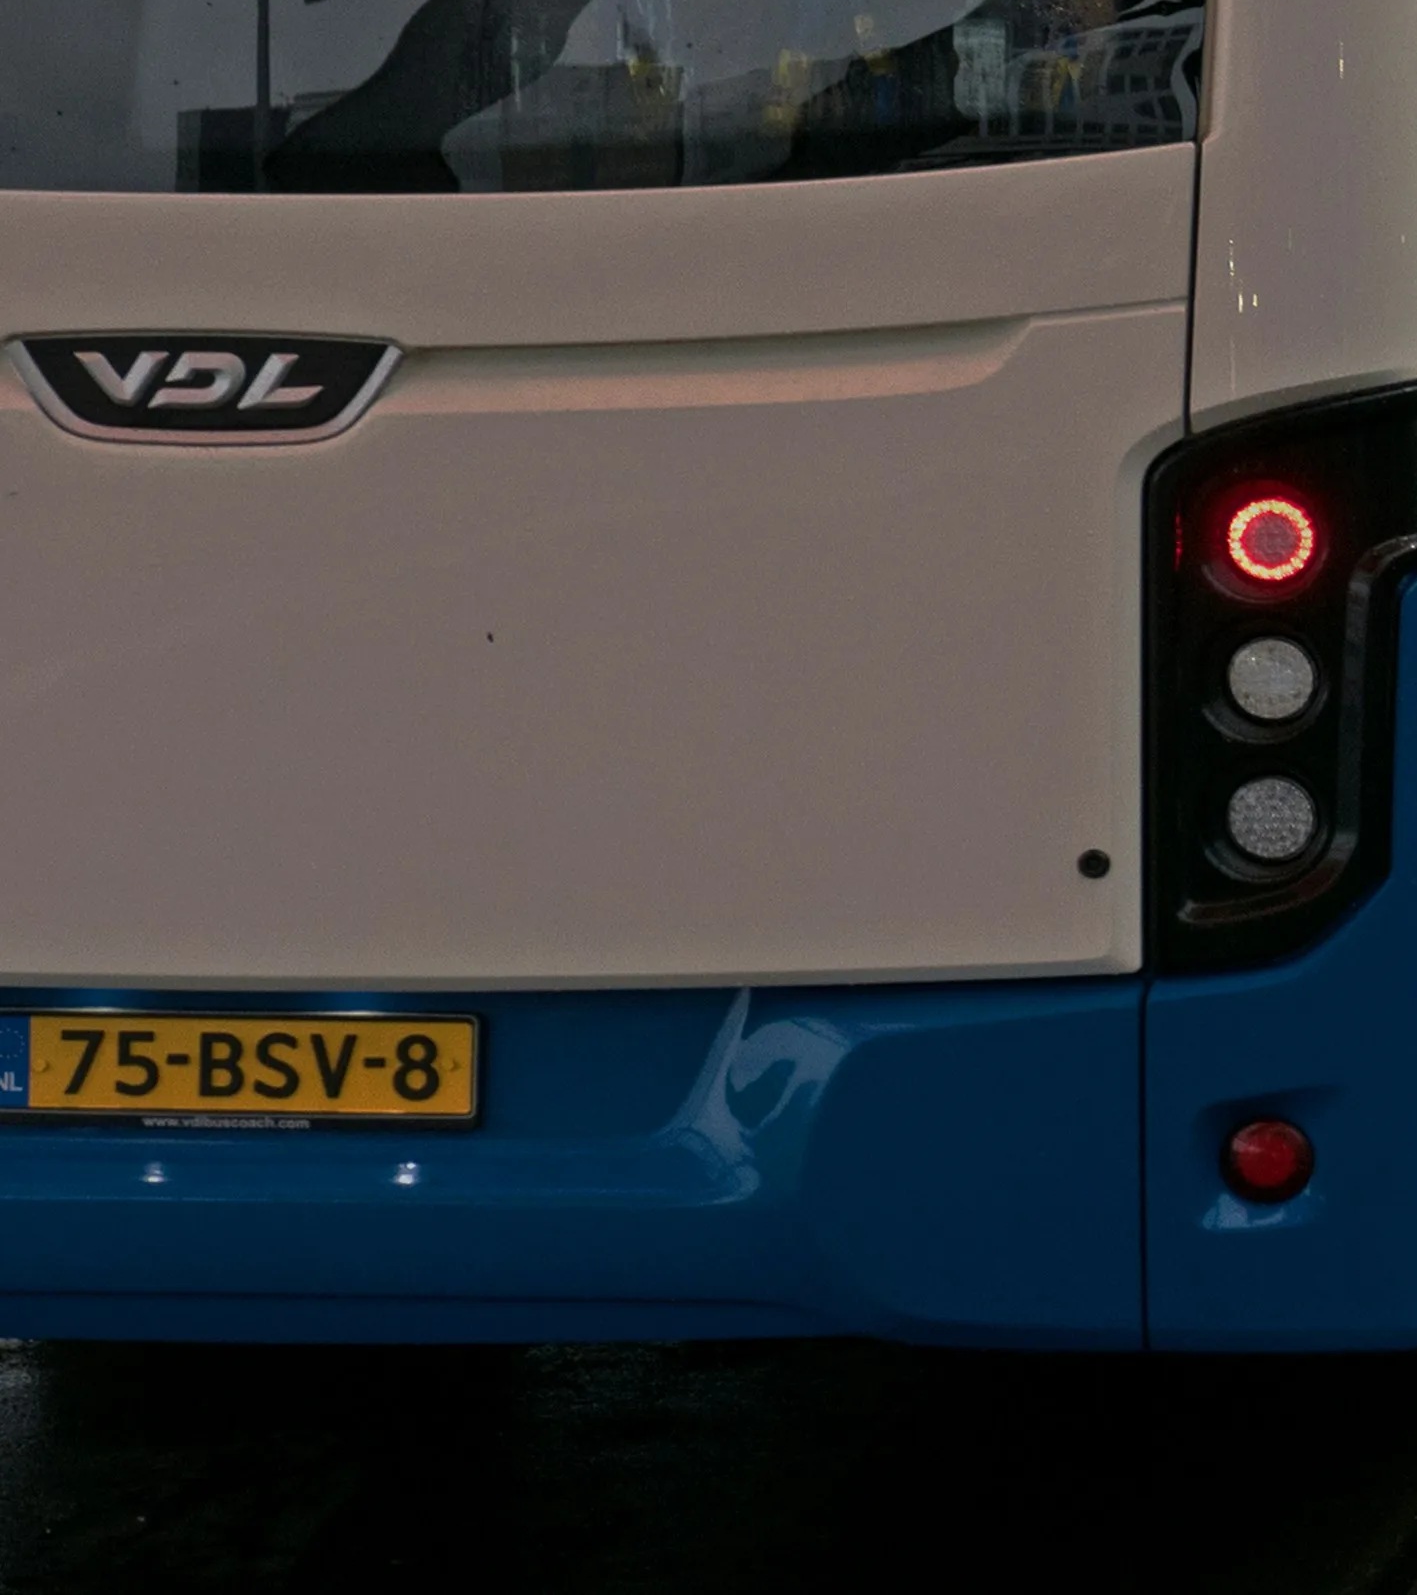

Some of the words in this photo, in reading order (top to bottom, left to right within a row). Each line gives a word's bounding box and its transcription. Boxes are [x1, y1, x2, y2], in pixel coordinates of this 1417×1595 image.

[73, 350, 325, 410] VDL
[61, 1029, 440, 1101] 75-BSV-8
[142, 1116, 311, 1130] www.vdlbuscoach.com
